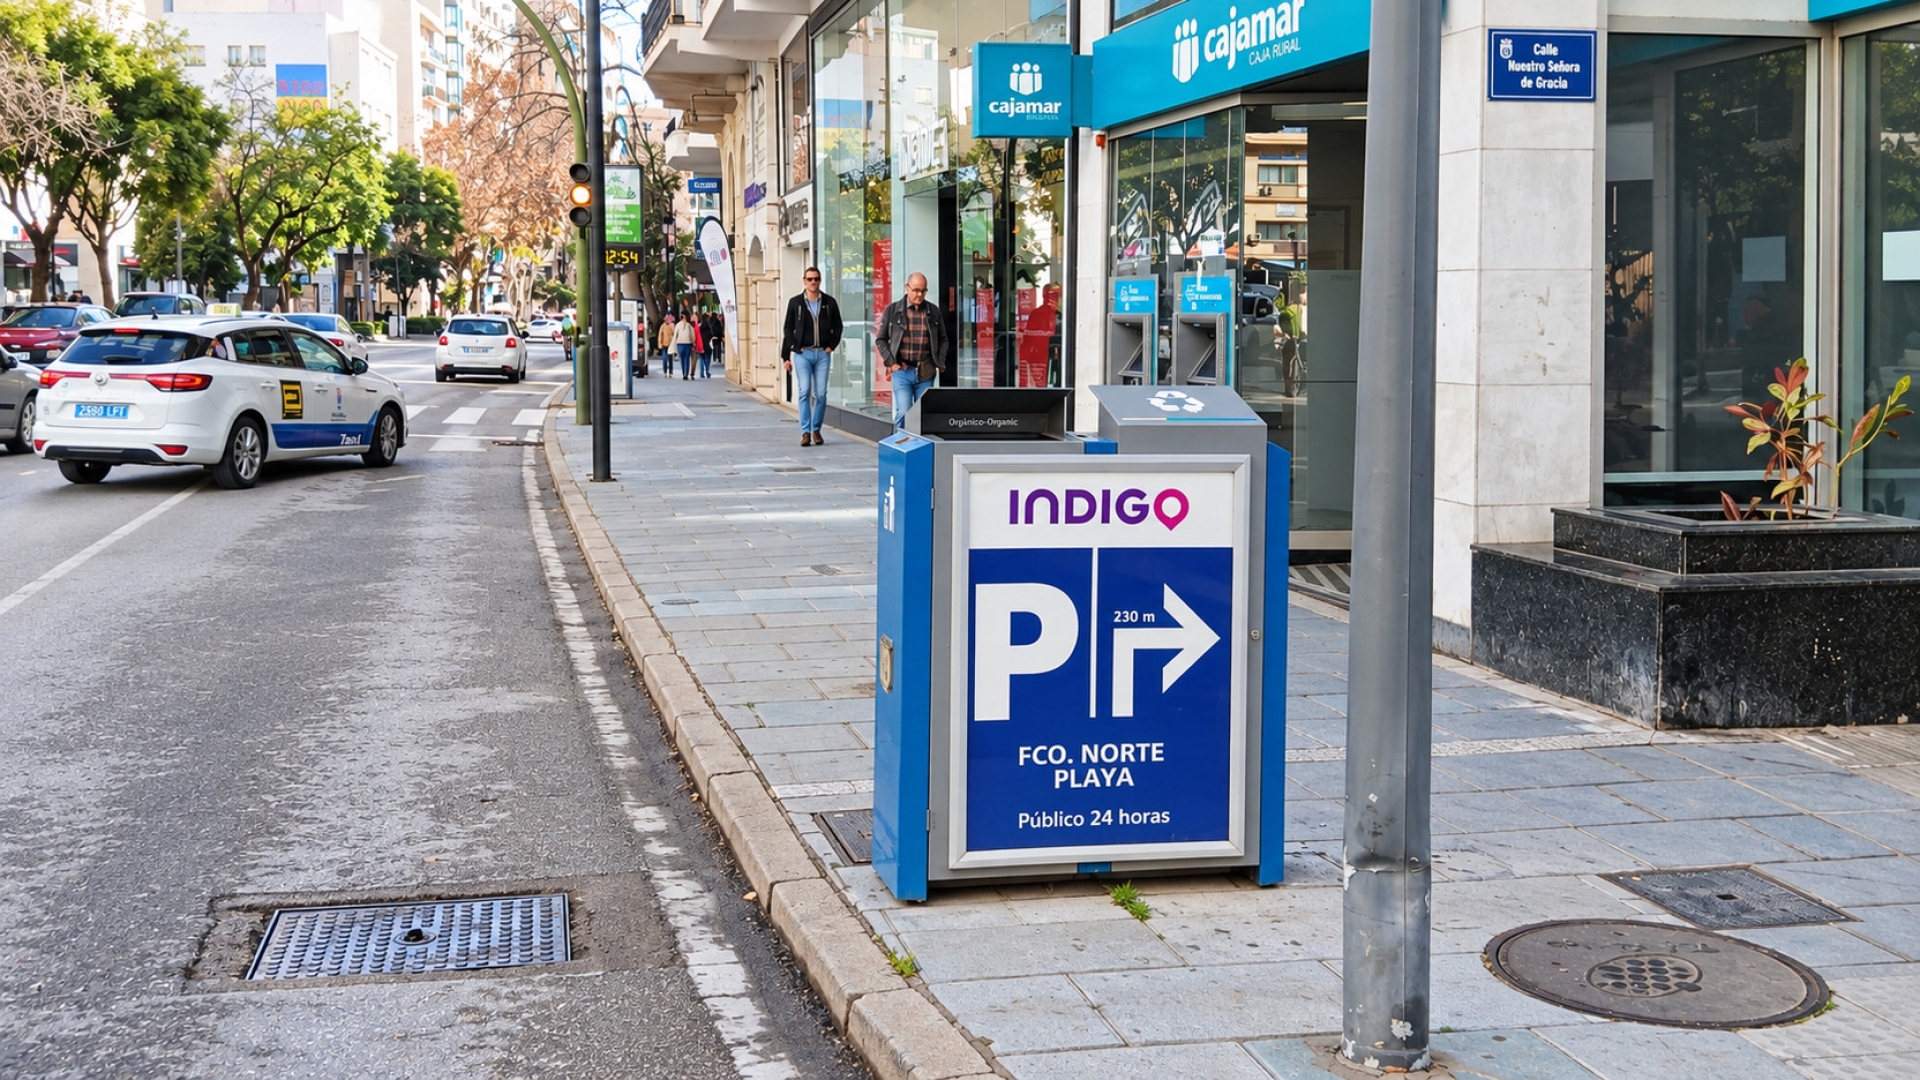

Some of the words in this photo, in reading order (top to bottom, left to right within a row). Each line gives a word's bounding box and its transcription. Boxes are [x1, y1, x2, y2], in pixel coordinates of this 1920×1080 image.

[1204, 0, 1305, 70] cajamar
[1249, 47, 1271, 65] CAJA
[1272, 38, 1301, 59] RURAL
[1533, 43, 1559, 56] Calle
[1547, 60, 1581, 73] Señora
[1520, 76, 1533, 88] de
[989, 97, 1062, 118] cajamar
[1009, 488, 1190, 531] INDIGO
[1113, 610, 1139, 623] 230
[1142, 613, 1156, 623] m
[974, 583, 1079, 721] P
[1019, 745, 1073, 766] FCO.
[1081, 742, 1165, 764] NORTE
[1054, 767, 1135, 789] PLAYA
[1018, 810, 1084, 829] Público
[1090, 810, 1113, 826] 24
[1119, 807, 1170, 826] horas
